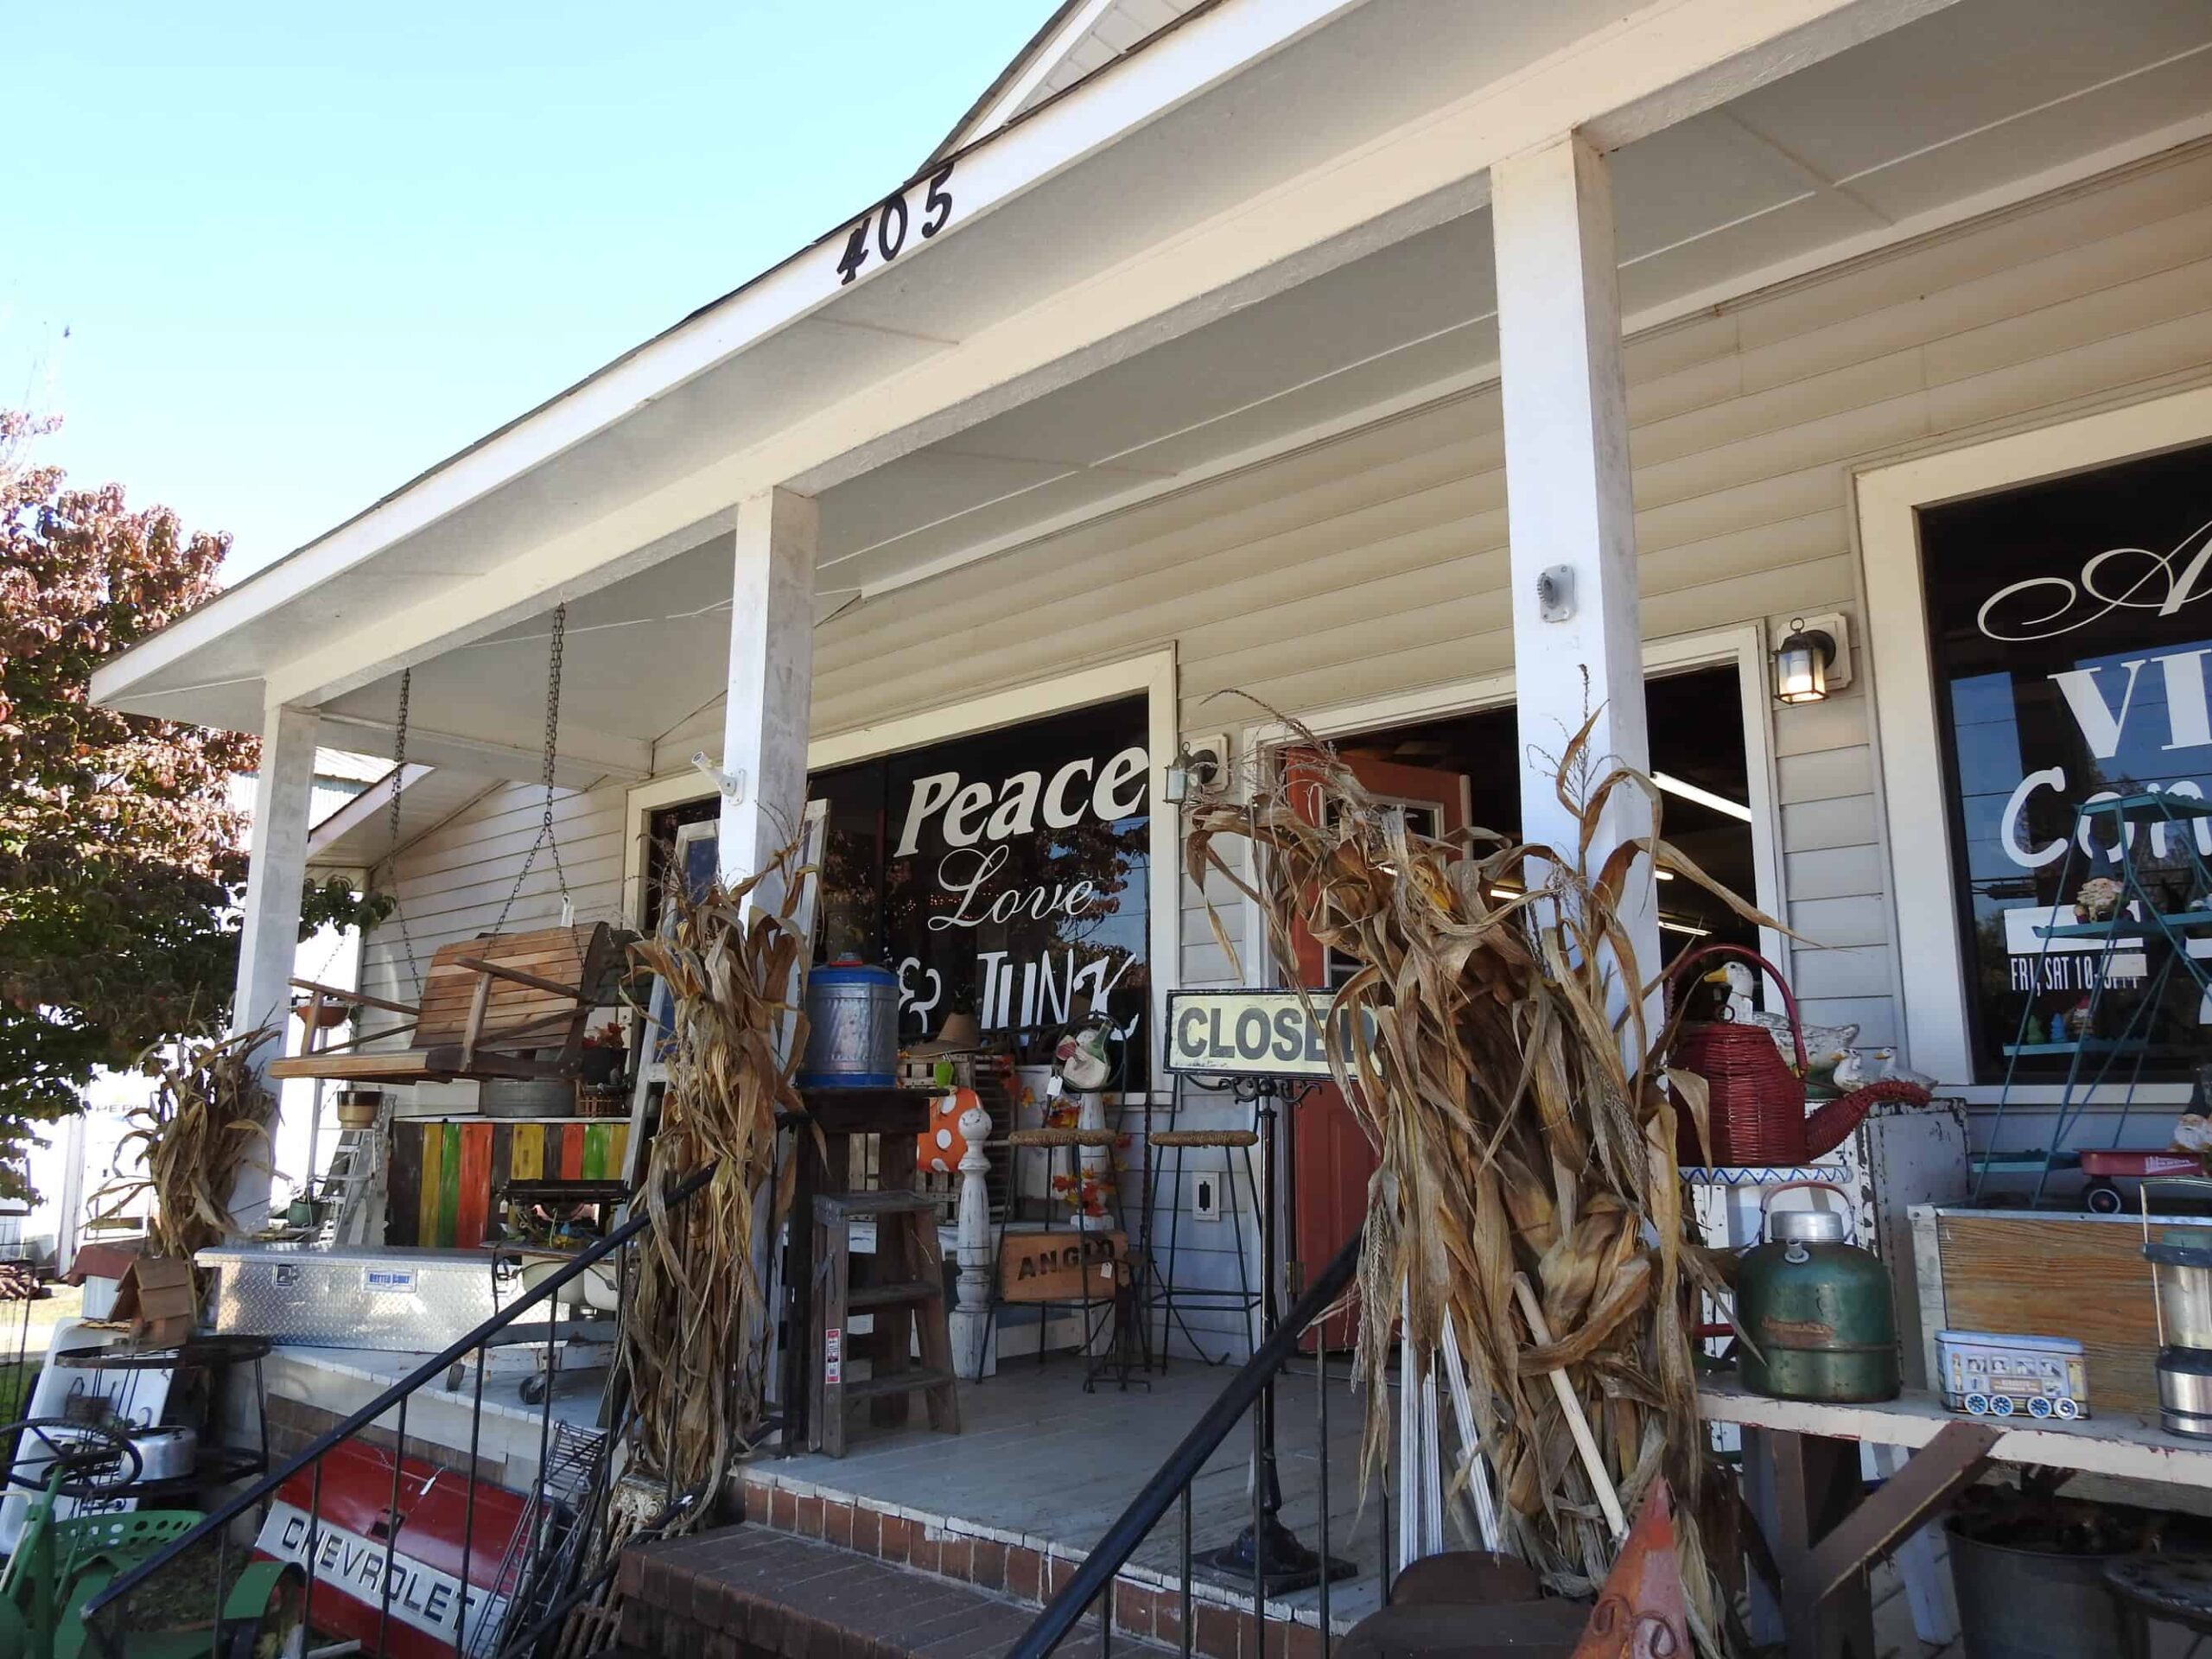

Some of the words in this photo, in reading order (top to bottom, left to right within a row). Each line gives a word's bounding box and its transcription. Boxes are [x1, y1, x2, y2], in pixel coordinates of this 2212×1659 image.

[836, 162, 954, 285] 405
[893, 747, 1150, 857] Peace
[927, 844, 1094, 931] Love
[2045, 957, 2070, 990] SAT
[1177, 1007, 1376, 1063] CLOSED
[282, 1517, 475, 1630] CHEVROLET
